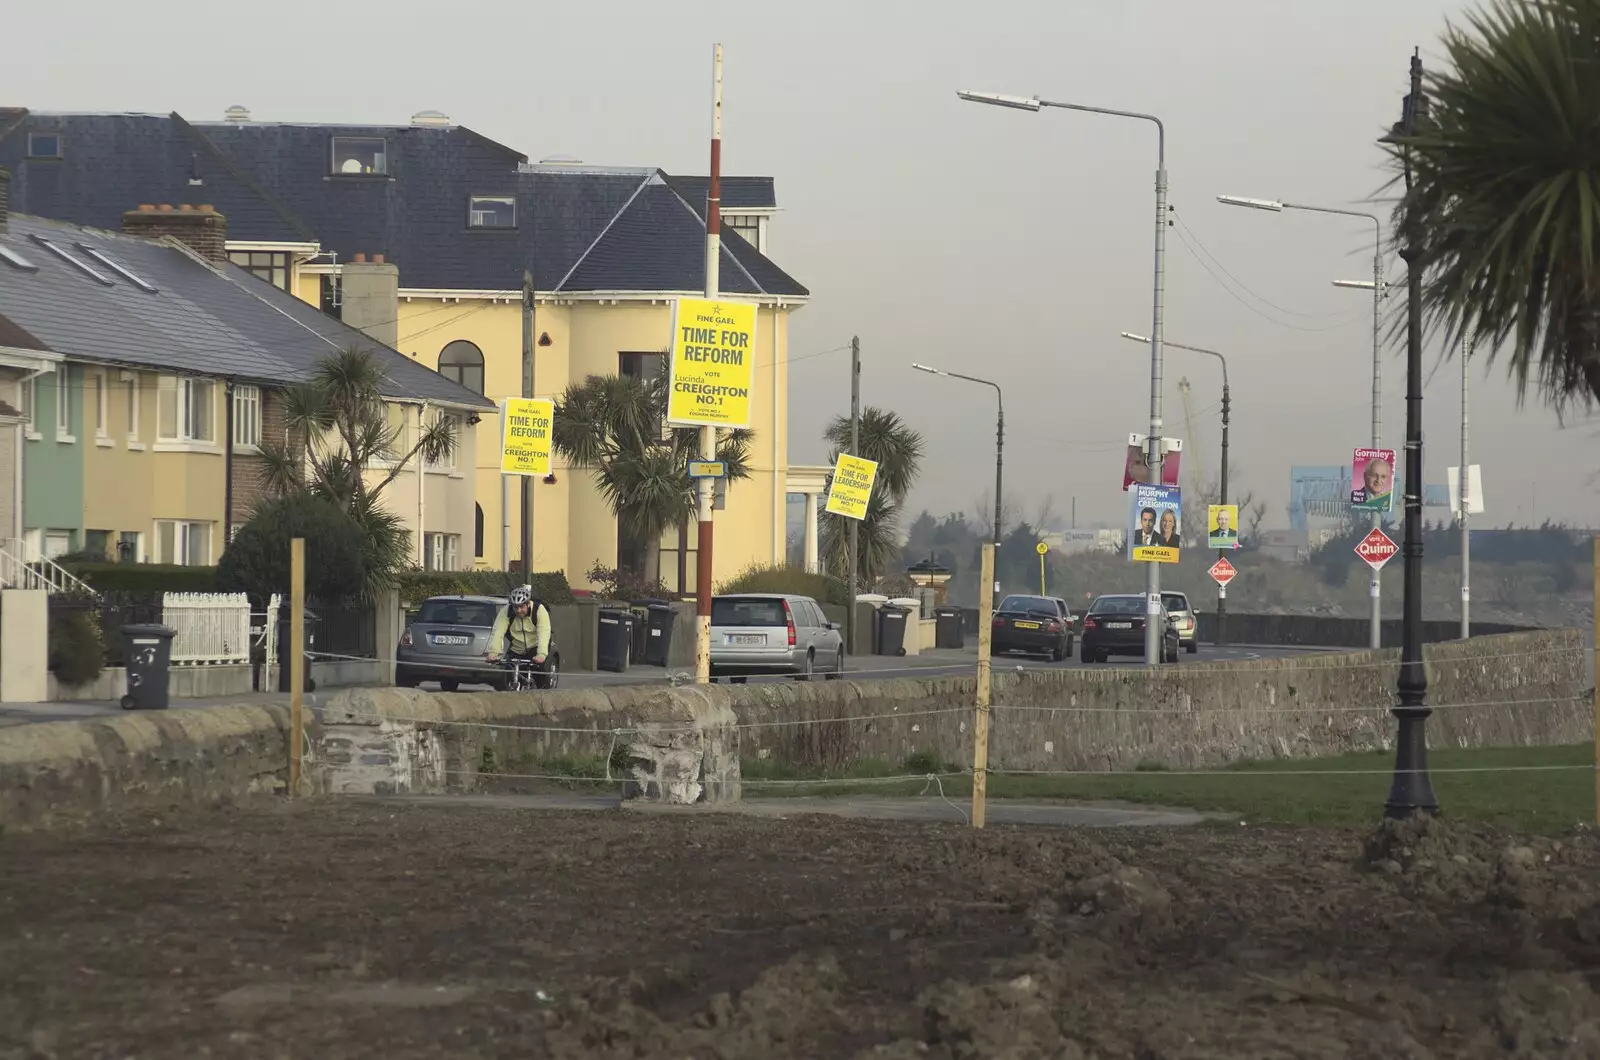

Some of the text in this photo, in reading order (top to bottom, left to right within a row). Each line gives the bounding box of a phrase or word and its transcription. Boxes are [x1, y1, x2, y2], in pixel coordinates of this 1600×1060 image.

[682, 326, 748, 348] TIME FOR
[684, 346, 743, 365] REFORM
[675, 374, 704, 383] Lucinda
[674, 383, 748, 397] CREIGHTON
[509, 416, 548, 428] TIME FOR
[511, 427, 545, 438] REFORM
[505, 449, 548, 458] CREIGHTON
[1355, 449, 1389, 460] Gormley
[841, 468, 868, 481] TIME FOR
[834, 476, 870, 491] LEADERSHIP
[831, 493, 866, 505] CREIGHTON
[1139, 490, 1168, 498] MURPHY
[1138, 500, 1178, 509] CREIGHTON
[1360, 543, 1394, 555] Quinn
[1212, 567, 1234, 576] Quinn
